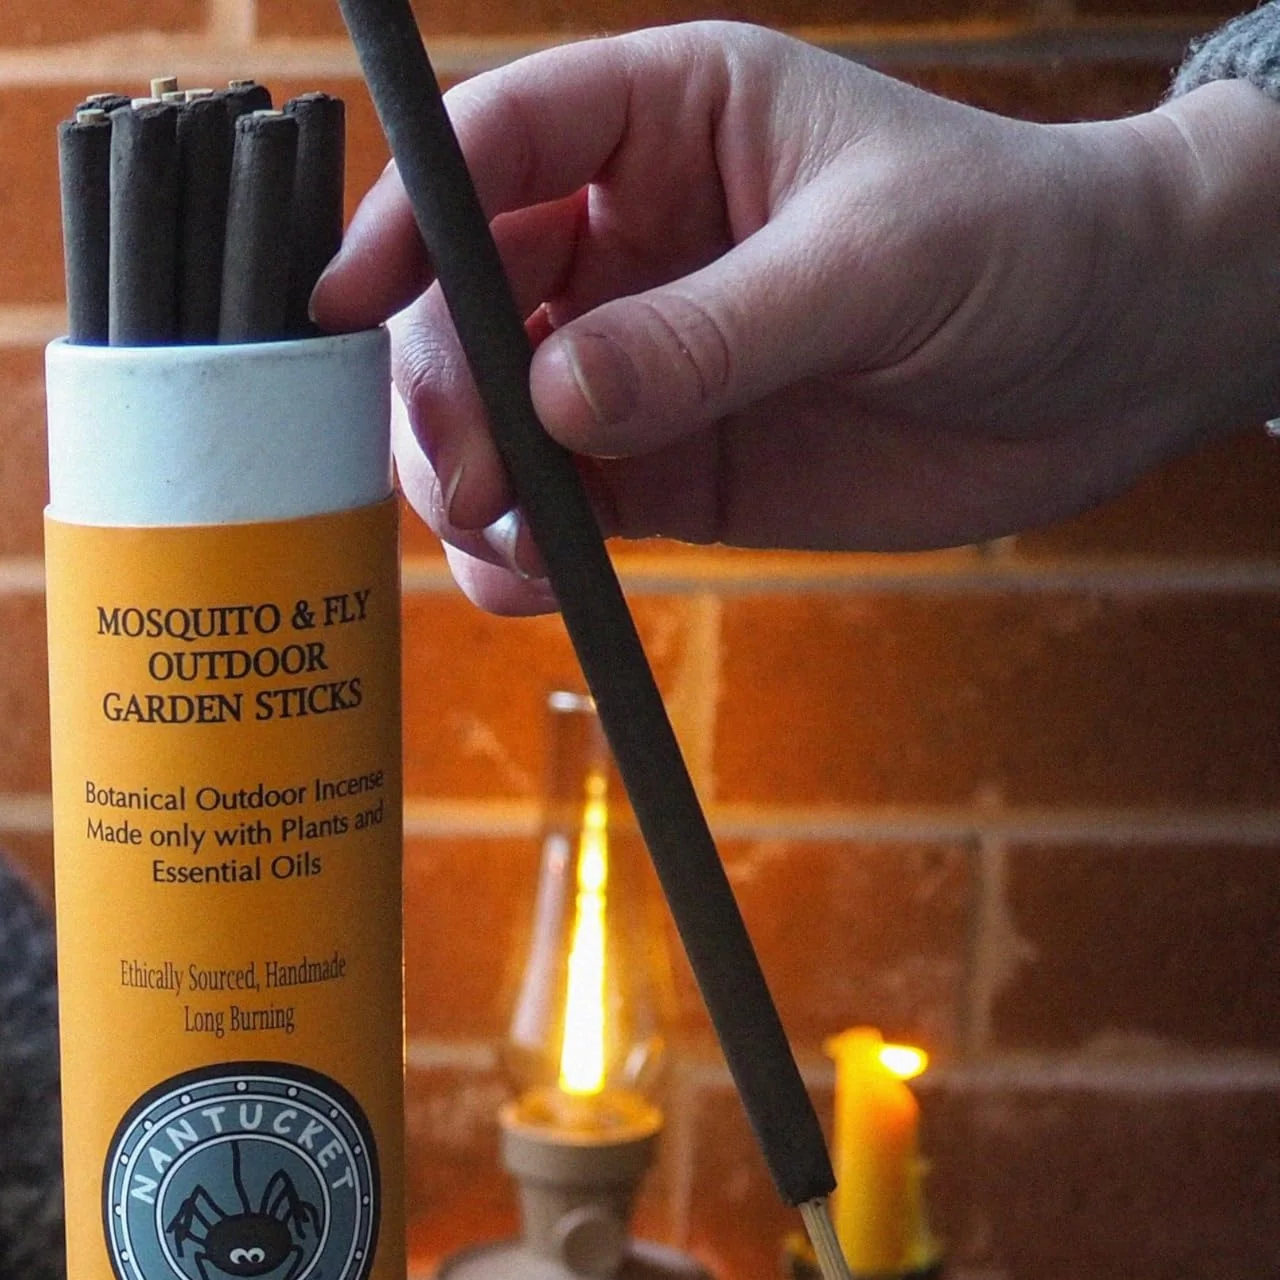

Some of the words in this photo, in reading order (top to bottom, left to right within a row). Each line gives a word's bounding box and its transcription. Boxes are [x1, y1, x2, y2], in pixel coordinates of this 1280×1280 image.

[97, 603, 281, 641] MOSQUITO
[291, 600, 316, 630] &
[323, 590, 370, 626] FLY
[148, 643, 328, 681] OUTDOOR
[103, 692, 243, 723] GARDEN
[255, 678, 363, 720] STICKS
[86, 781, 186, 811] Botanical
[196, 784, 307, 811] Outdoor
[315, 769, 384, 802] Incense
[87, 818, 142, 845] Made
[150, 823, 206, 854] only
[214, 824, 271, 846] with
[281, 816, 348, 842] Plants
[354, 802, 384, 830] and
[152, 858, 261, 883] Essential
[271, 852, 321, 879] Oils
[120, 959, 184, 996] Ethically
[188, 961, 261, 993] Sourced,
[265, 951, 347, 990] Handmade
[184, 1005, 224, 1038] Long
[230, 1003, 295, 1034] Burning
[131, 1103, 354, 1205] NANTUCKET
